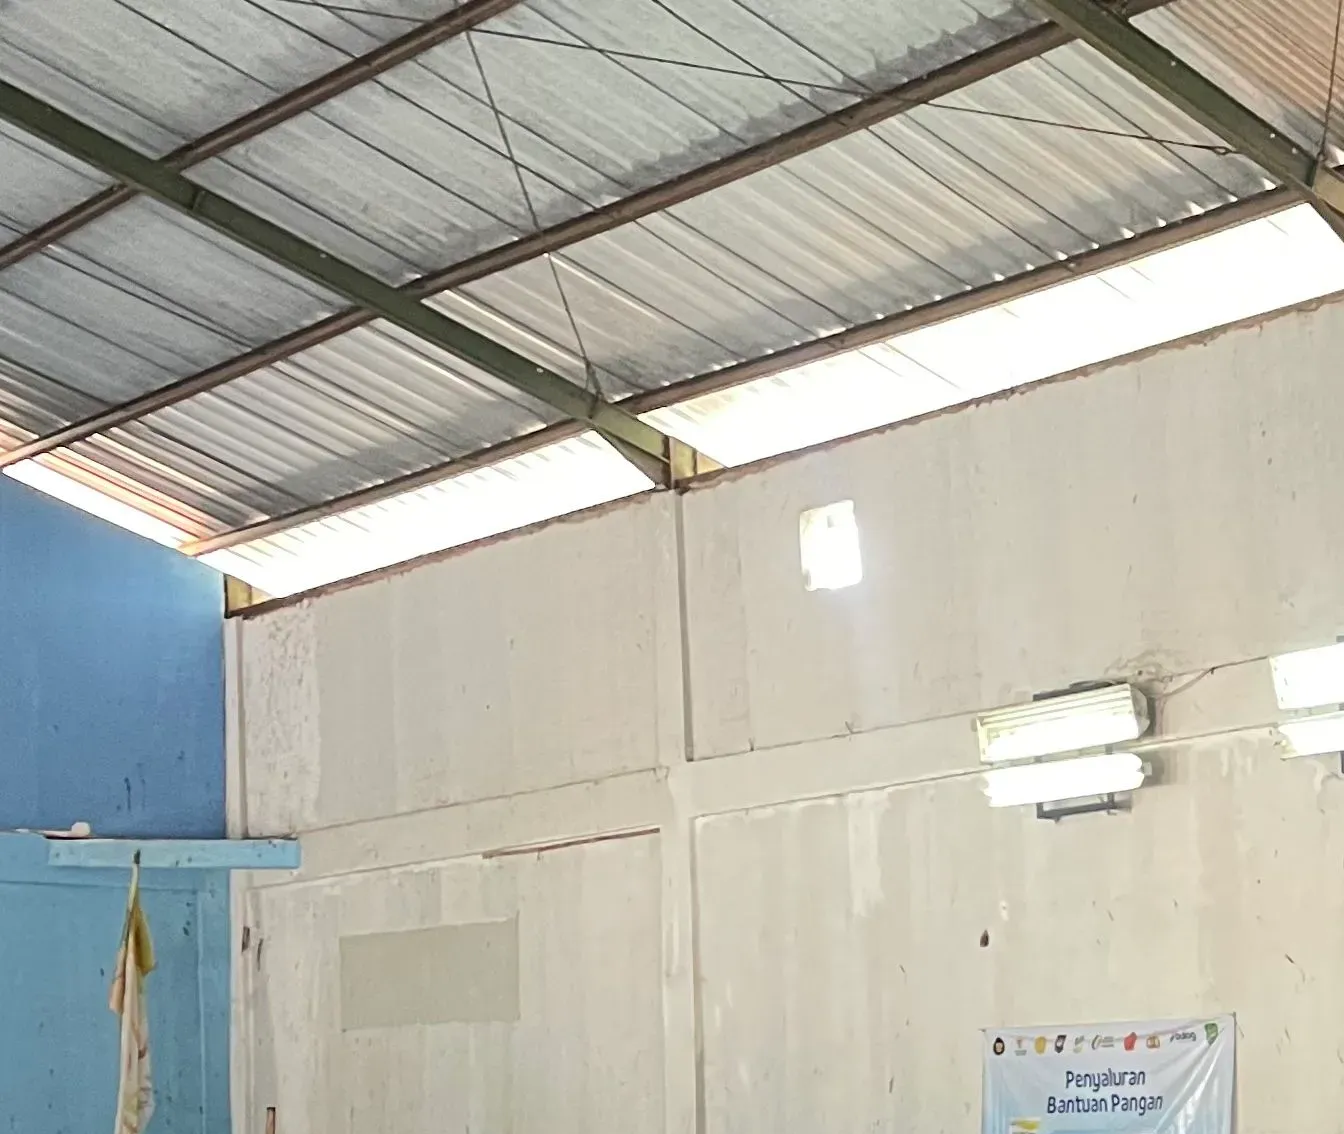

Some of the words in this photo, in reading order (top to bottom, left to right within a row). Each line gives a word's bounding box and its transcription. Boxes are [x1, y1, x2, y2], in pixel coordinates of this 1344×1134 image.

[1064, 1067, 1146, 1092] Penyaluran
[1046, 1096, 1108, 1115] Bantuan
[1111, 1094, 1163, 1117] Pangan
